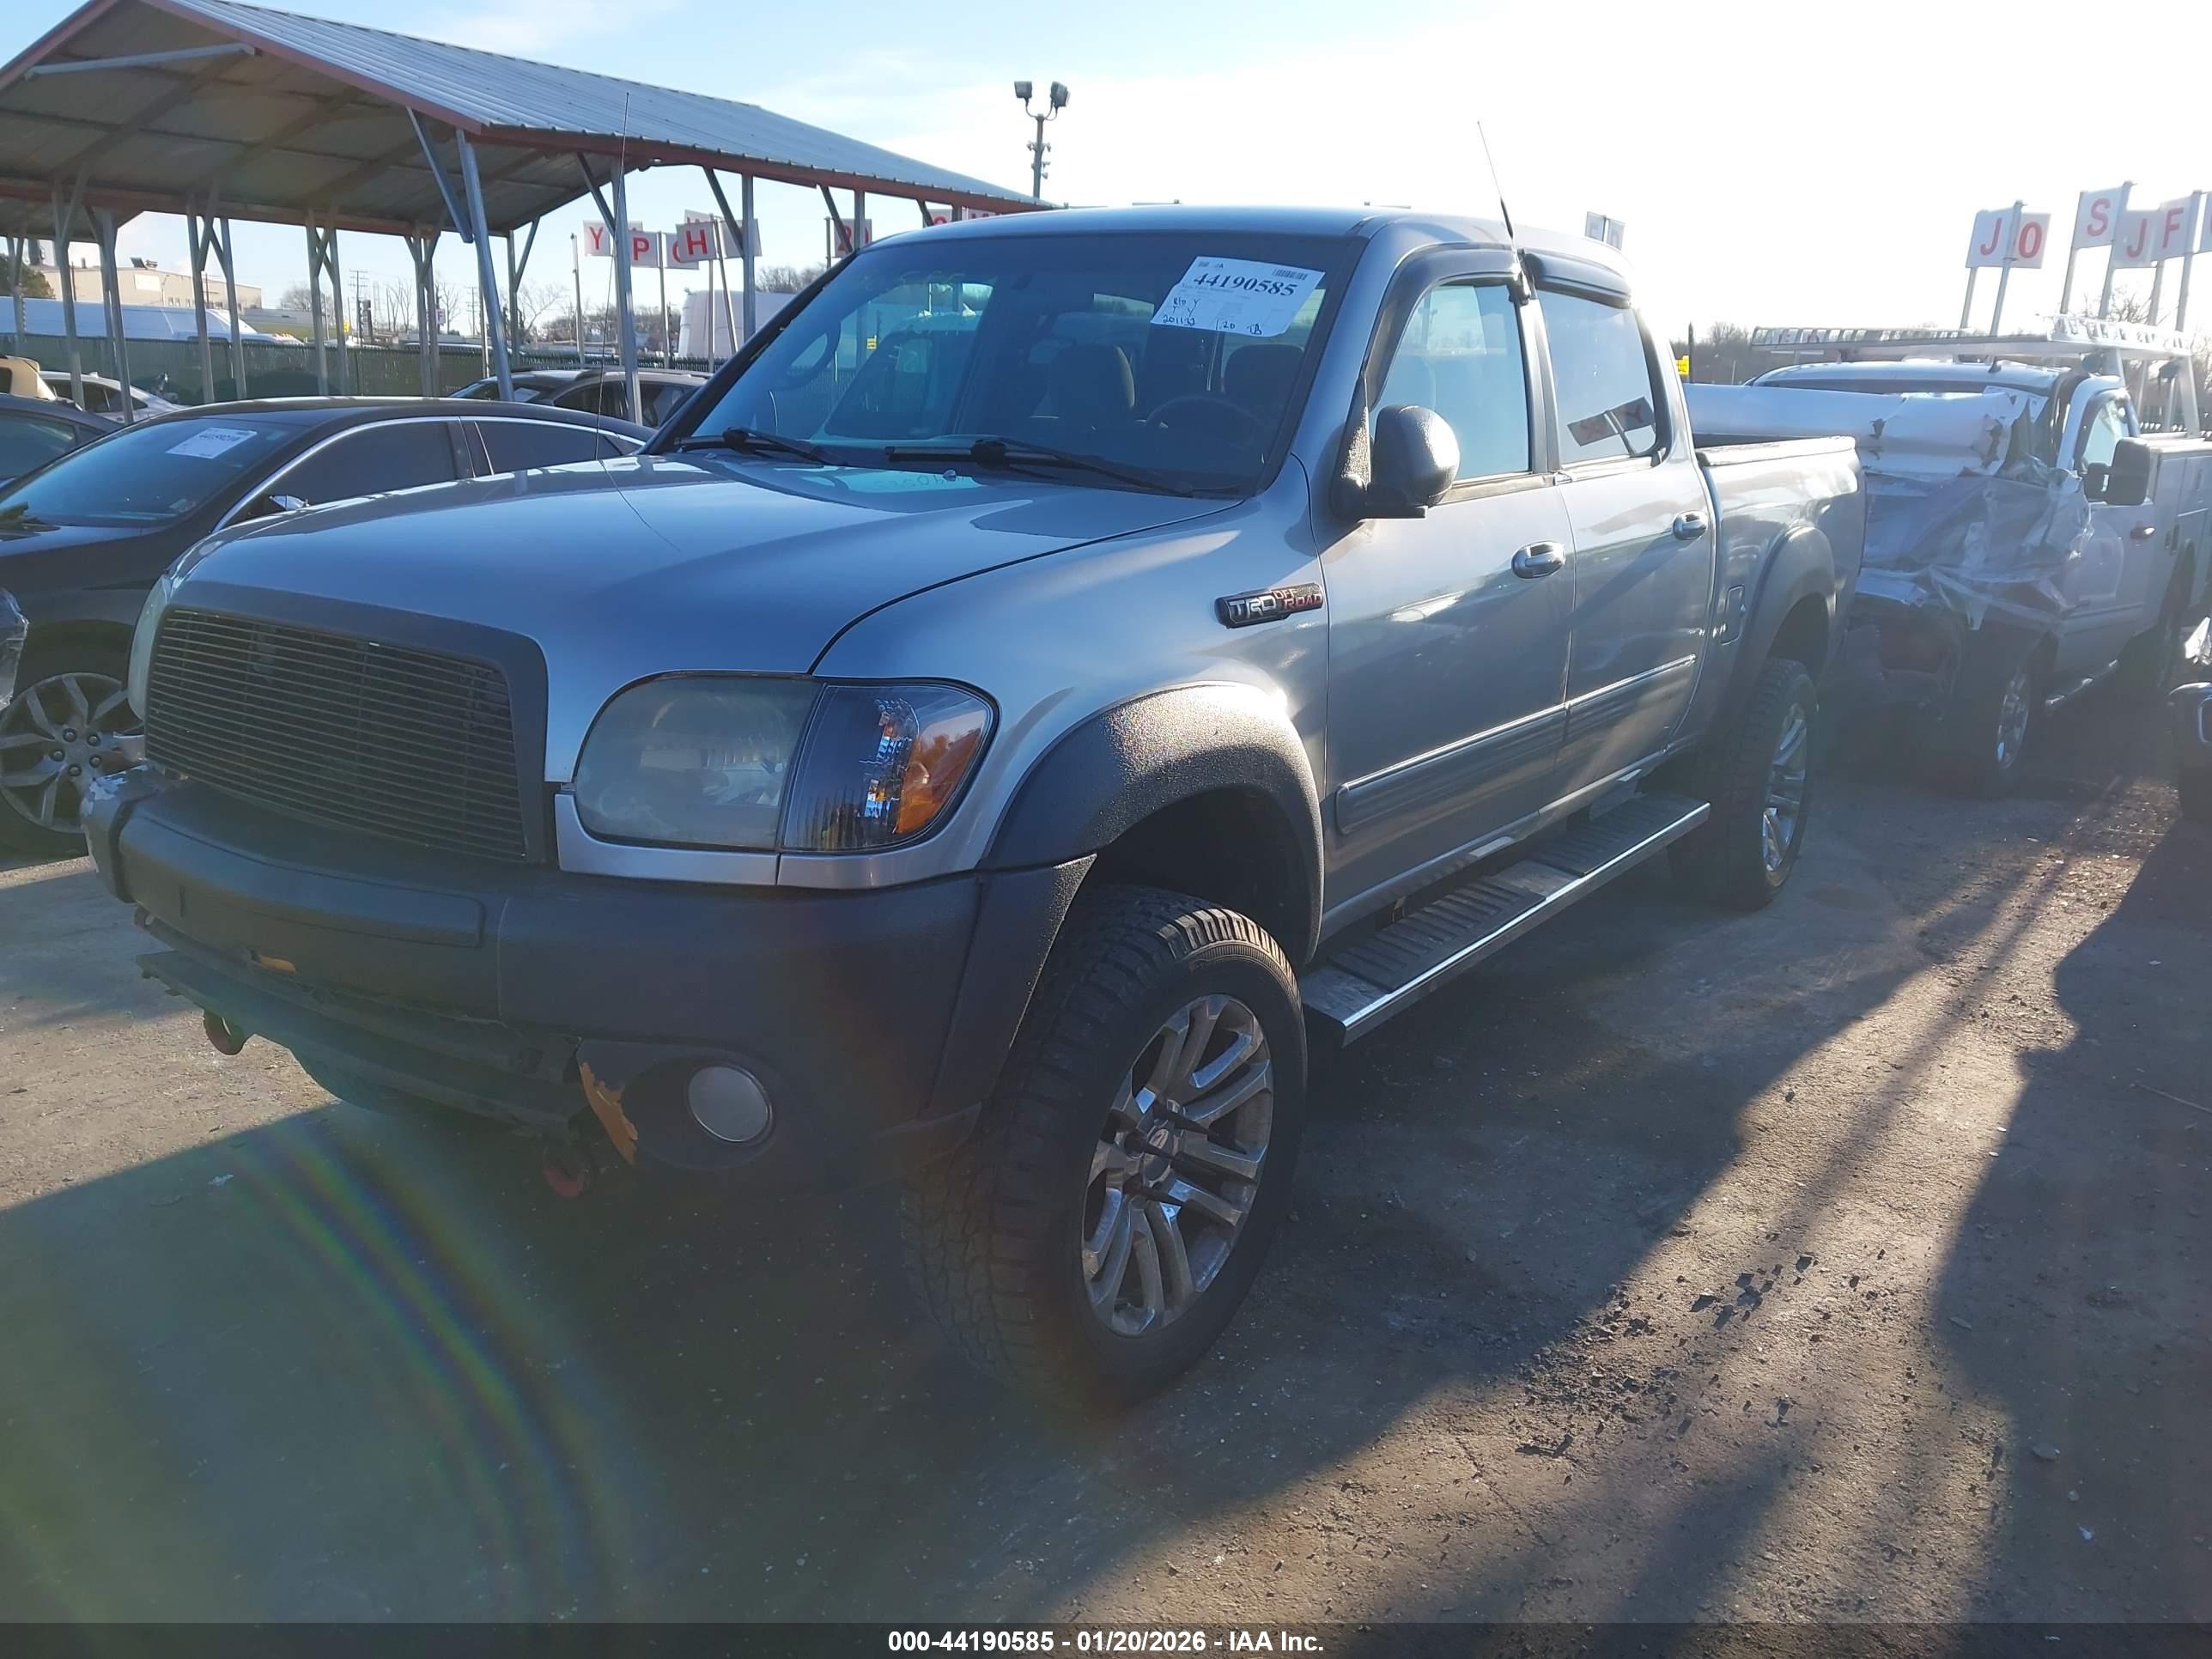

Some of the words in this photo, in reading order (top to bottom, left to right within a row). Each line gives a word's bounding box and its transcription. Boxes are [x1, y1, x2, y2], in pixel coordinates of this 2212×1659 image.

[2087, 198, 2111, 237] S
[2162, 206, 2185, 249] F
[589, 226, 605, 251] Y
[686, 228, 709, 256] H
[1979, 217, 2003, 256] J
[2126, 217, 2148, 258] J
[633, 237, 650, 262] P
[1193, 272, 1298, 296] 44190585
[1273, 589, 1298, 599] OFF
[1284, 593, 1322, 611] ROAD
[1229, 595, 1277, 619] TRD
